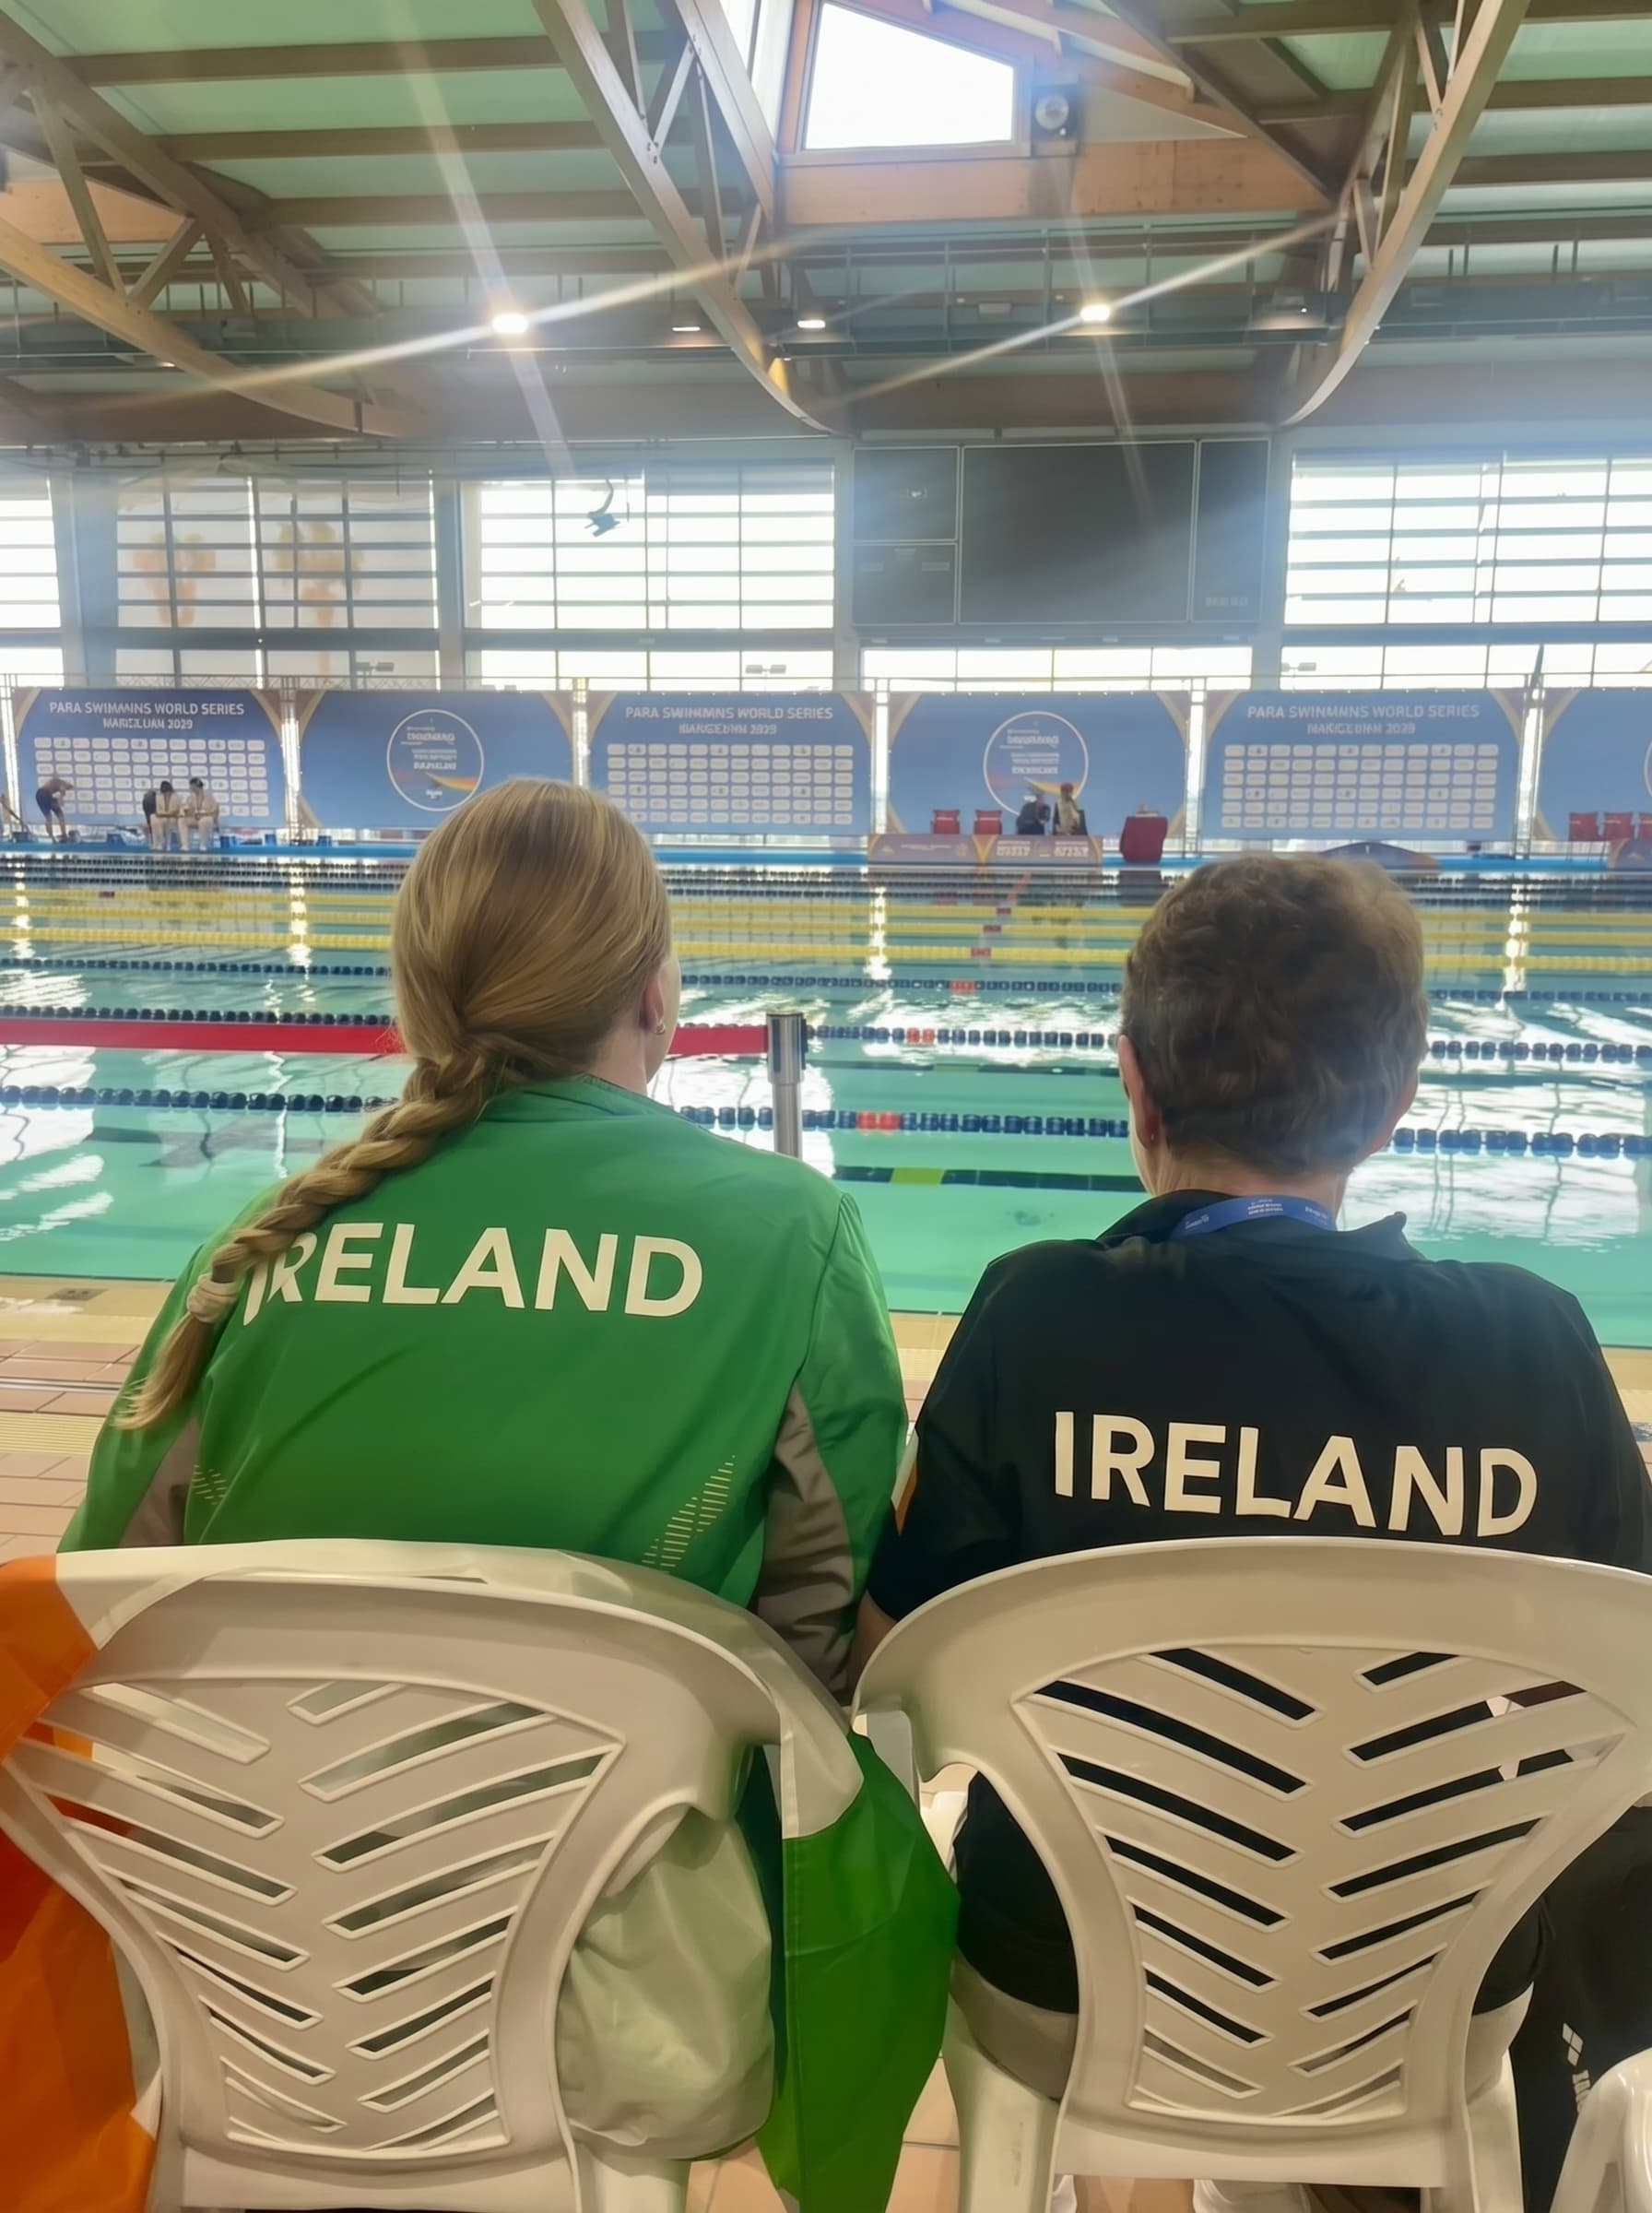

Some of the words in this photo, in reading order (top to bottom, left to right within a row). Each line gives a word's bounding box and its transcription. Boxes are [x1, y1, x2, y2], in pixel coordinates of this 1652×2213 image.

[49, 702, 82, 714] PARA
[154, 703, 199, 716] WORLD
[201, 704, 245, 716] SERIES
[625, 706, 660, 719] PARA
[737, 706, 785, 719] WORLD
[786, 706, 834, 720] SERIES
[1247, 706, 1284, 719] PARA
[1372, 704, 1424, 719] WORLD
[1427, 704, 1481, 719] SERIES
[243, 1223, 703, 1326] IRELAND
[1056, 1412, 1538, 1537] IRELAND
